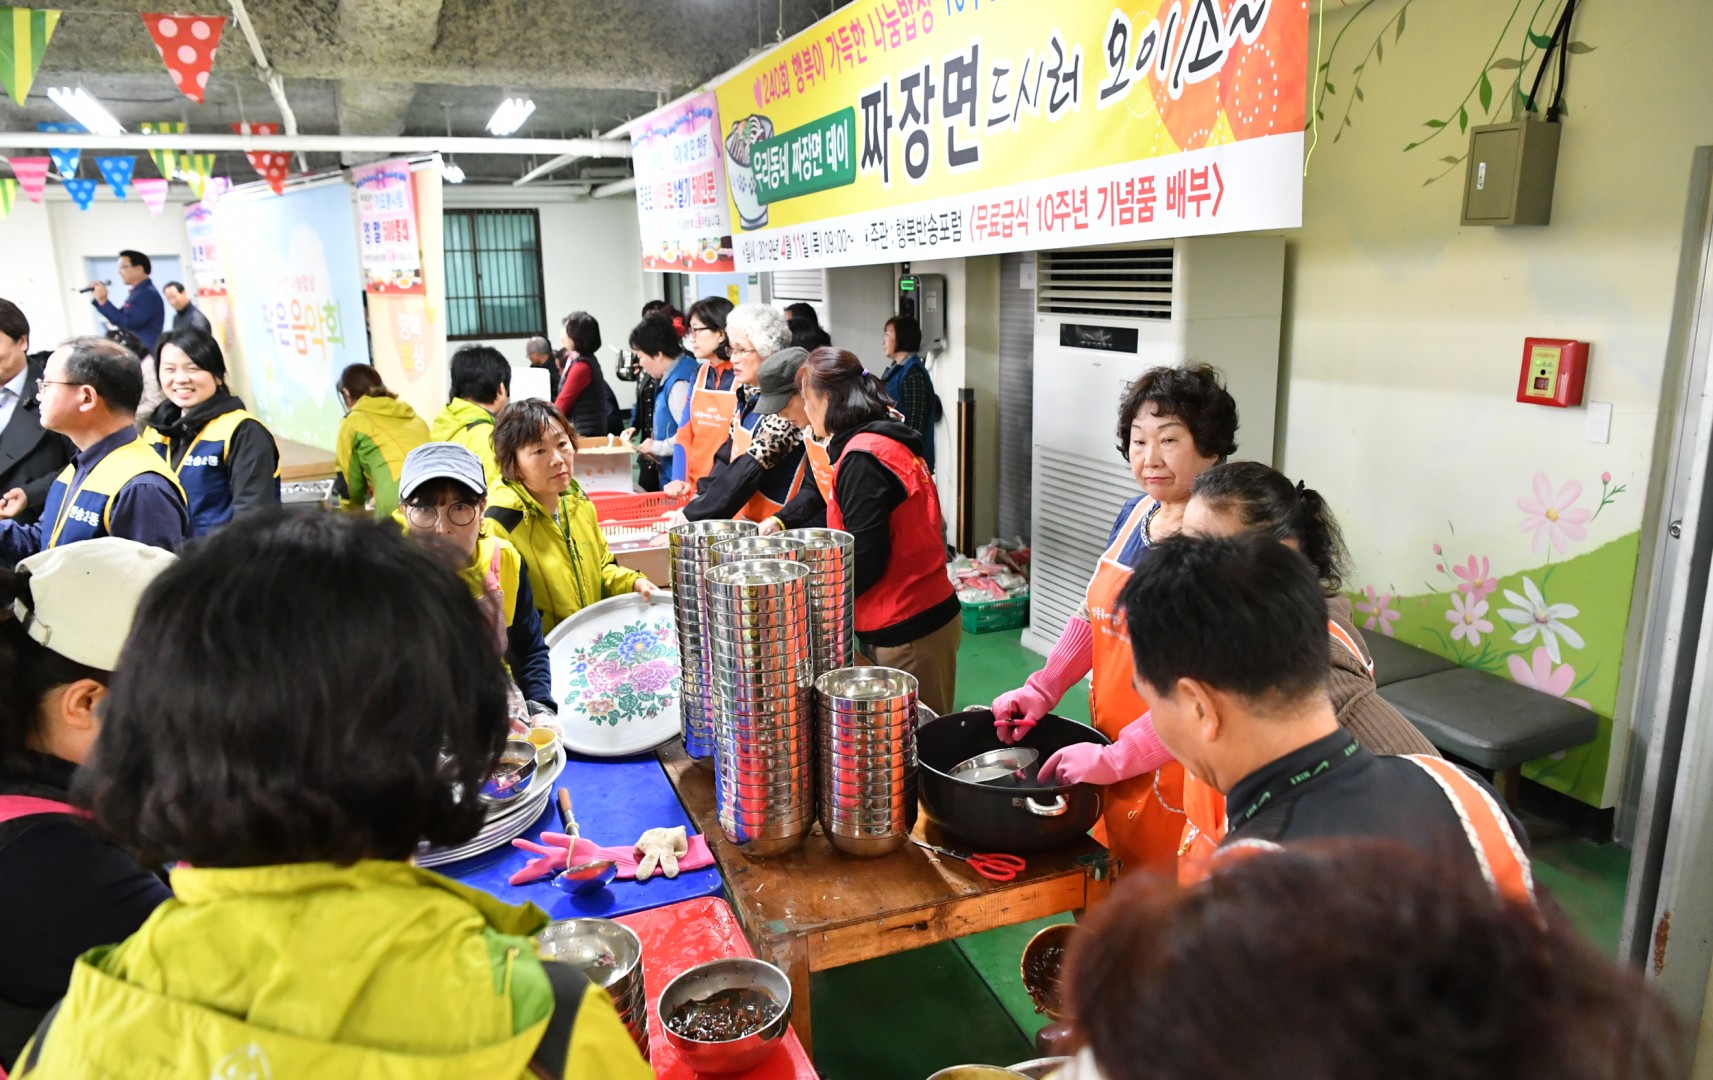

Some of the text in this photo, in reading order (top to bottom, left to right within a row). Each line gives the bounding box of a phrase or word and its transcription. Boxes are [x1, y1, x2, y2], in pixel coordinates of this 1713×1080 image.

[763, 60, 791, 105] 240회
[791, 40, 826, 94] 행복이
[826, 18, 867, 73] 가득한
[861, 44, 979, 183] 짜장면
[987, 36, 1079, 128] 드시러
[753, 119, 849, 193] 우리동네 짜장면 데이
[896, 208, 962, 249] 행복반송포럼
[1036, 185, 1089, 232] 10주년
[1097, 175, 1157, 227] 기념품
